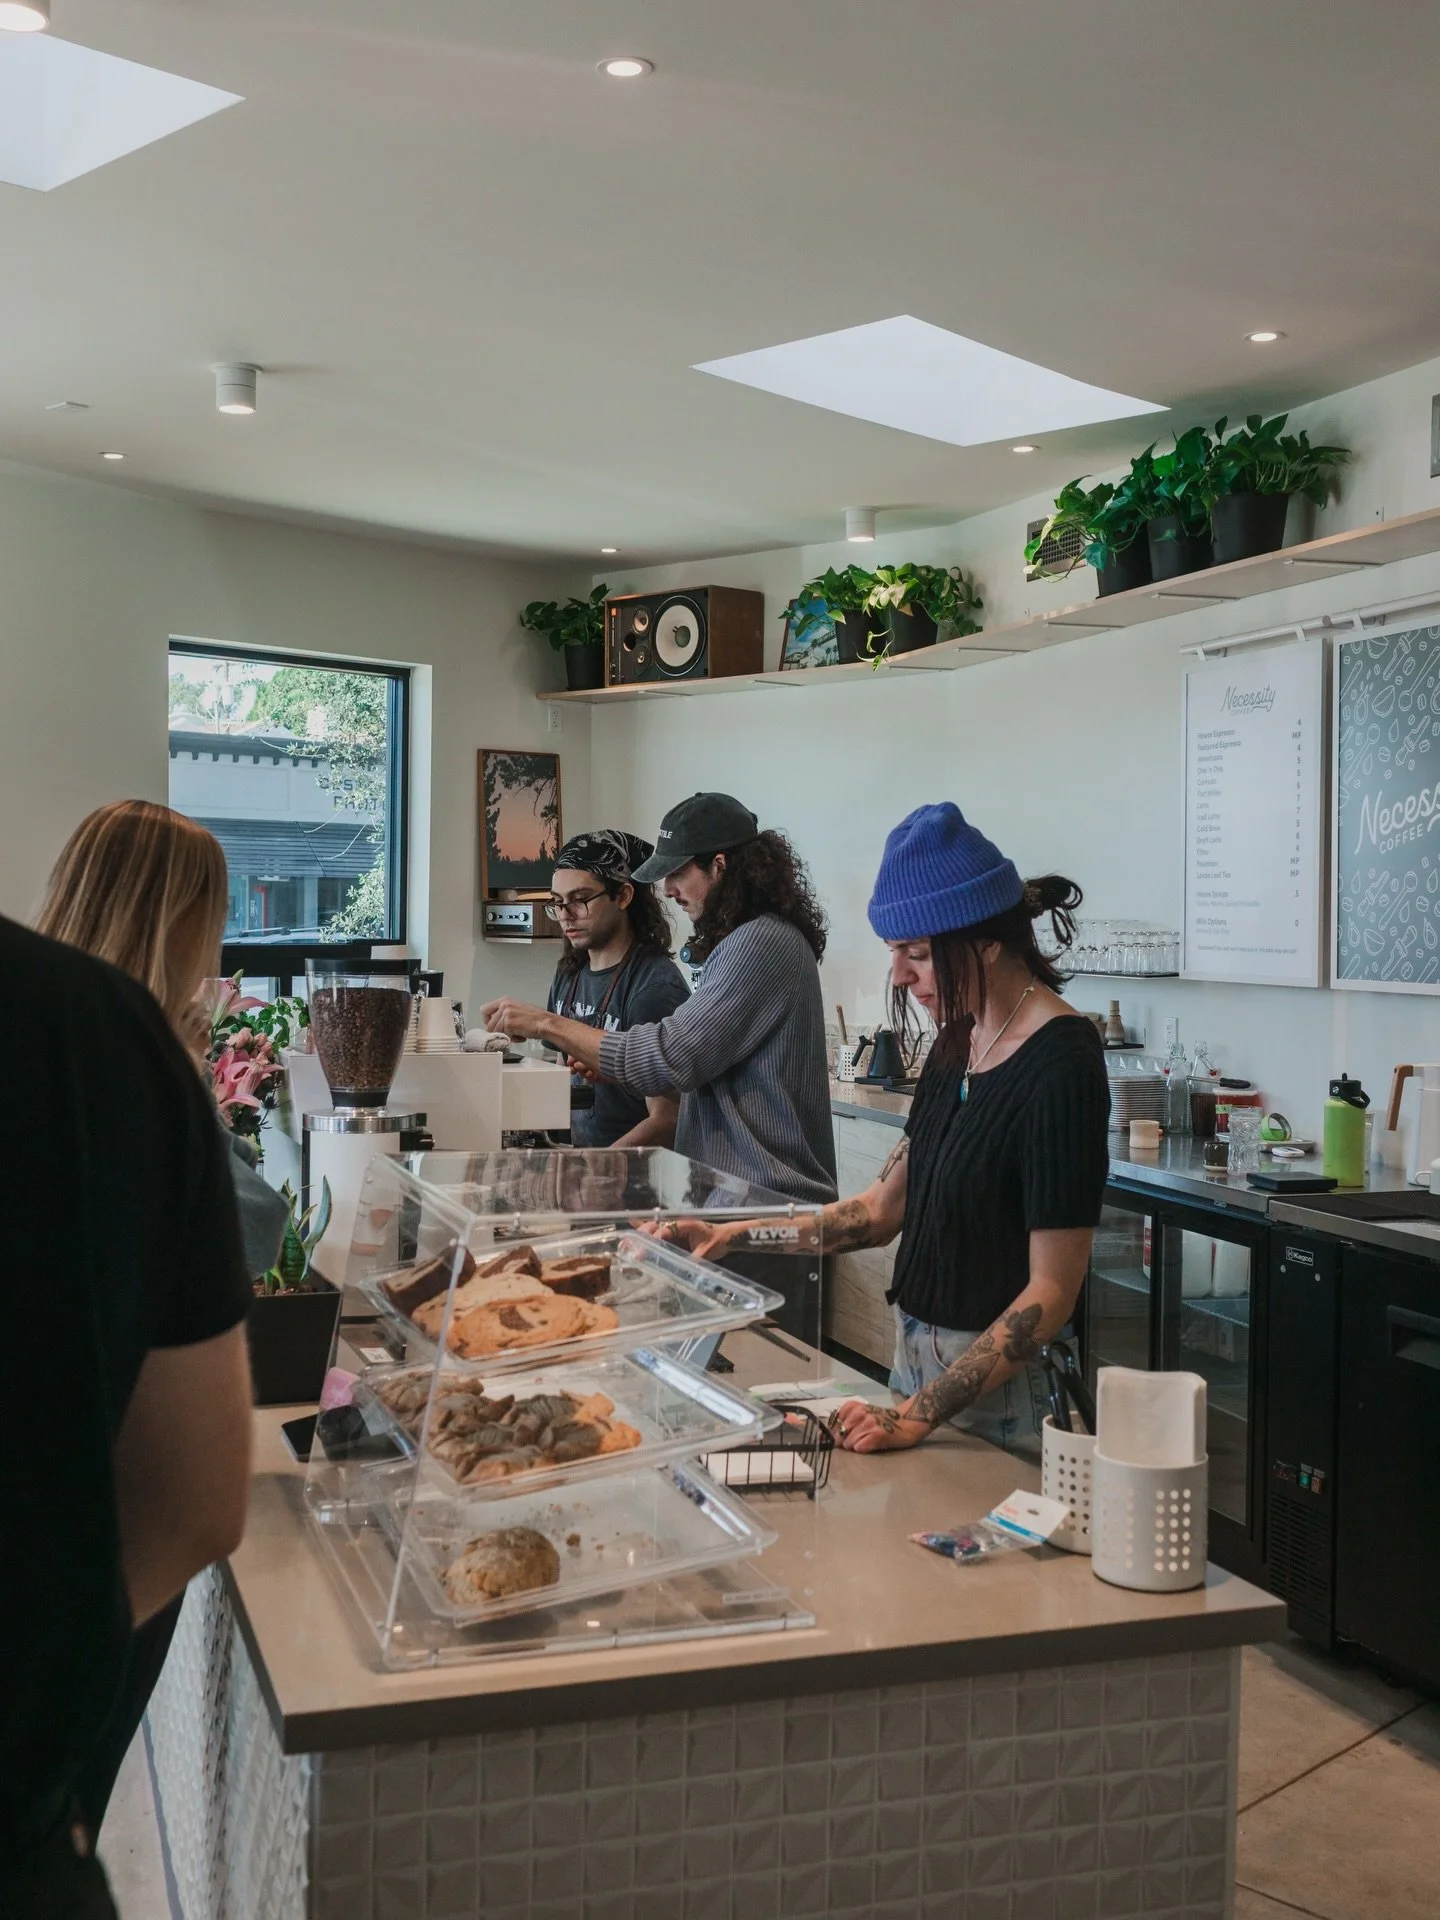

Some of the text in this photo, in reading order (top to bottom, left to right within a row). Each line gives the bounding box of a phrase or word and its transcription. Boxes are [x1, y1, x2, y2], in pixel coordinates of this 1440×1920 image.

[1220, 682, 1276, 713] Necessity
[1292, 731, 1301, 739] MP
[1379, 823, 1423, 854] COFFEE
[1290, 856, 1300, 865] MP
[1290, 869, 1300, 877] MP
[748, 1226, 799, 1240] VEVOR
[1293, 1252, 1312, 1262] Kegco
